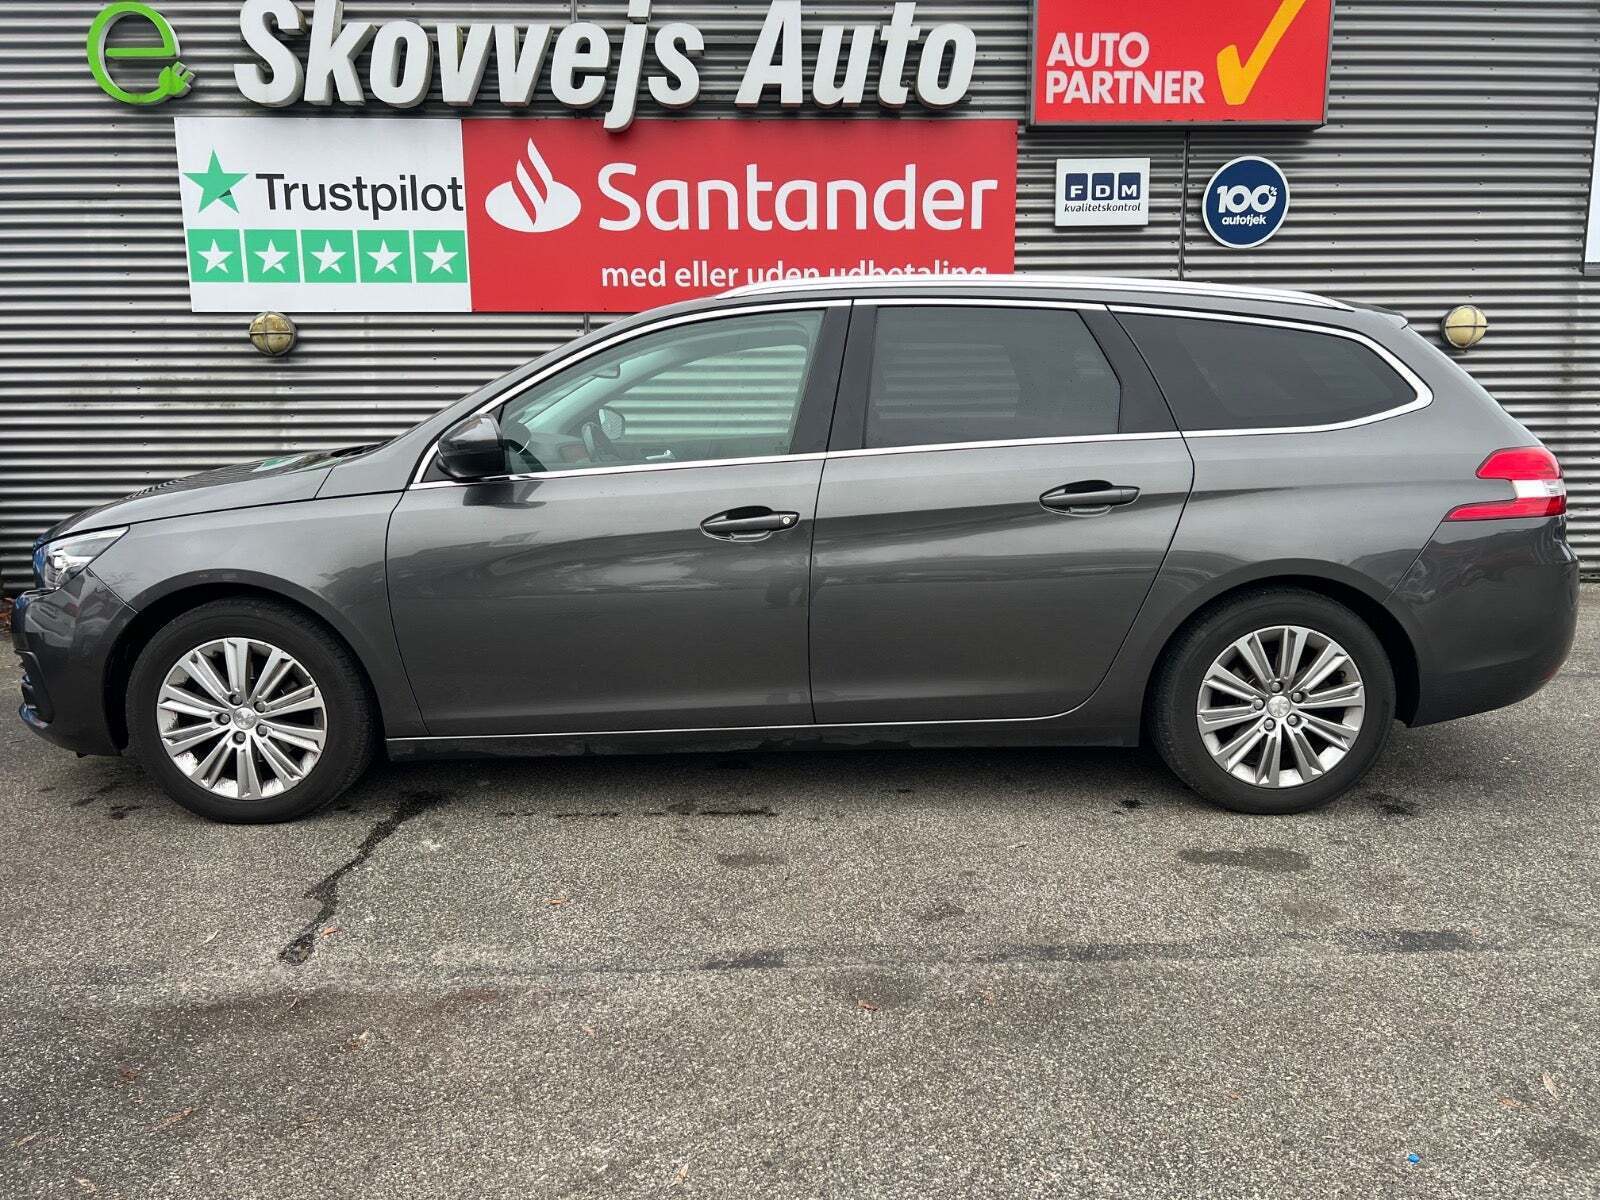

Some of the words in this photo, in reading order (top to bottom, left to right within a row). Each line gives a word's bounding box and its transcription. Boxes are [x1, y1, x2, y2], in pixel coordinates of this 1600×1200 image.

[234, 0, 705, 132] Skovvejs
[734, 0, 977, 108] Auto
[1046, 31, 1150, 68] AUTO
[1045, 70, 1206, 104] PARTNER
[255, 173, 464, 220] Trustpilot
[598, 163, 998, 232] Santander
[1064, 202, 1141, 213] kvalitetskontrol
[1221, 214, 1267, 226] autotjek
[601, 260, 667, 287] med
[674, 260, 739, 287] eller
